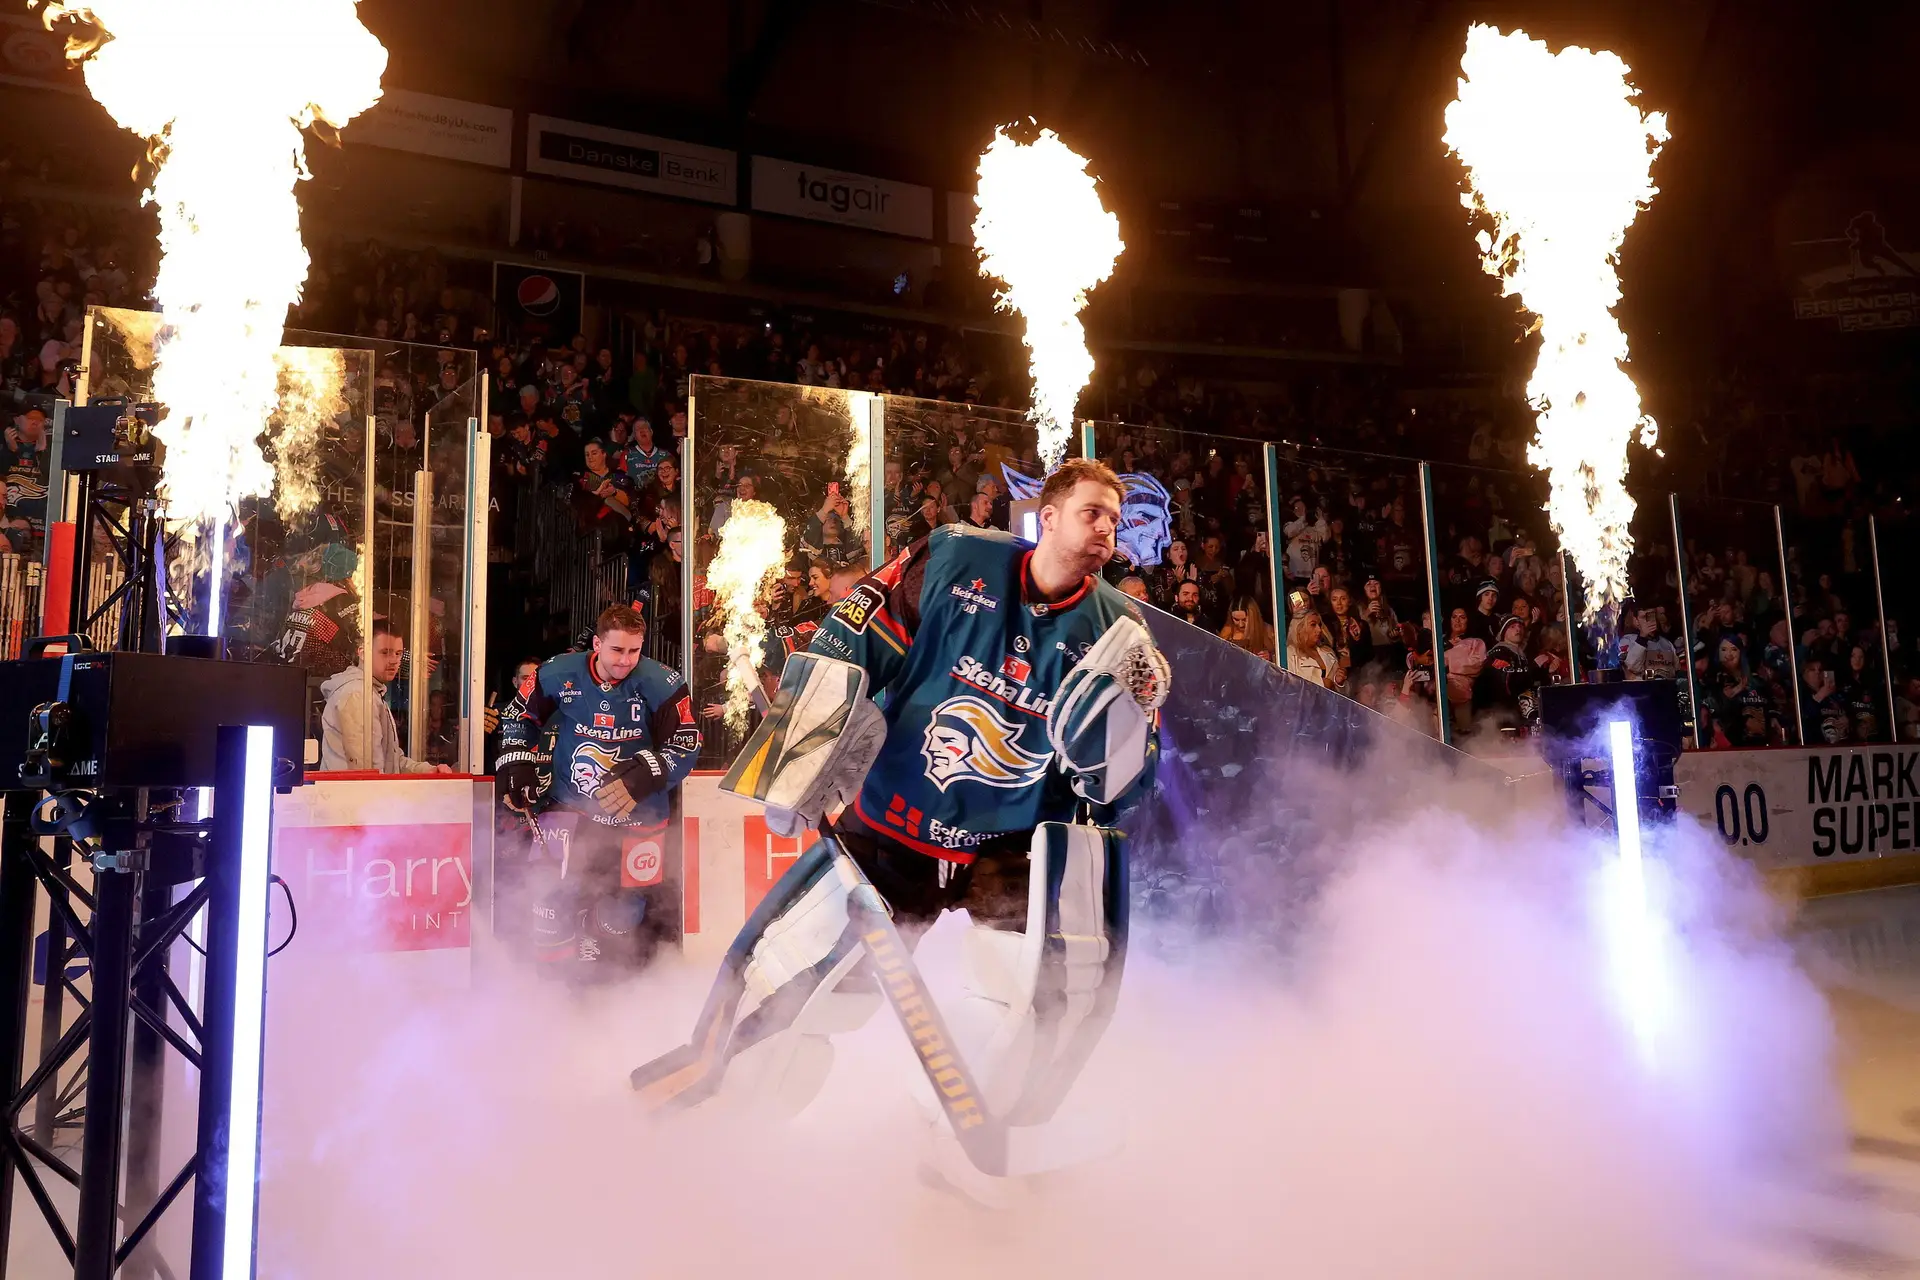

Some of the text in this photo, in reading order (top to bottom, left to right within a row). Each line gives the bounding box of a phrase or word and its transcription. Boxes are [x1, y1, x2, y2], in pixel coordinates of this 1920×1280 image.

[568, 141, 720, 184] Danske Bank
[798, 171, 891, 213] tagair
[839, 602, 866, 625] CAB
[951, 586, 997, 609] Heineken
[631, 703, 640, 722] C
[1015, 687, 1052, 716] Lin
[574, 723, 642, 740] Stena Line
[1715, 782, 1769, 847] 0.0
[306, 847, 472, 907] Harry
[861, 928, 986, 1130] WARRIOR
